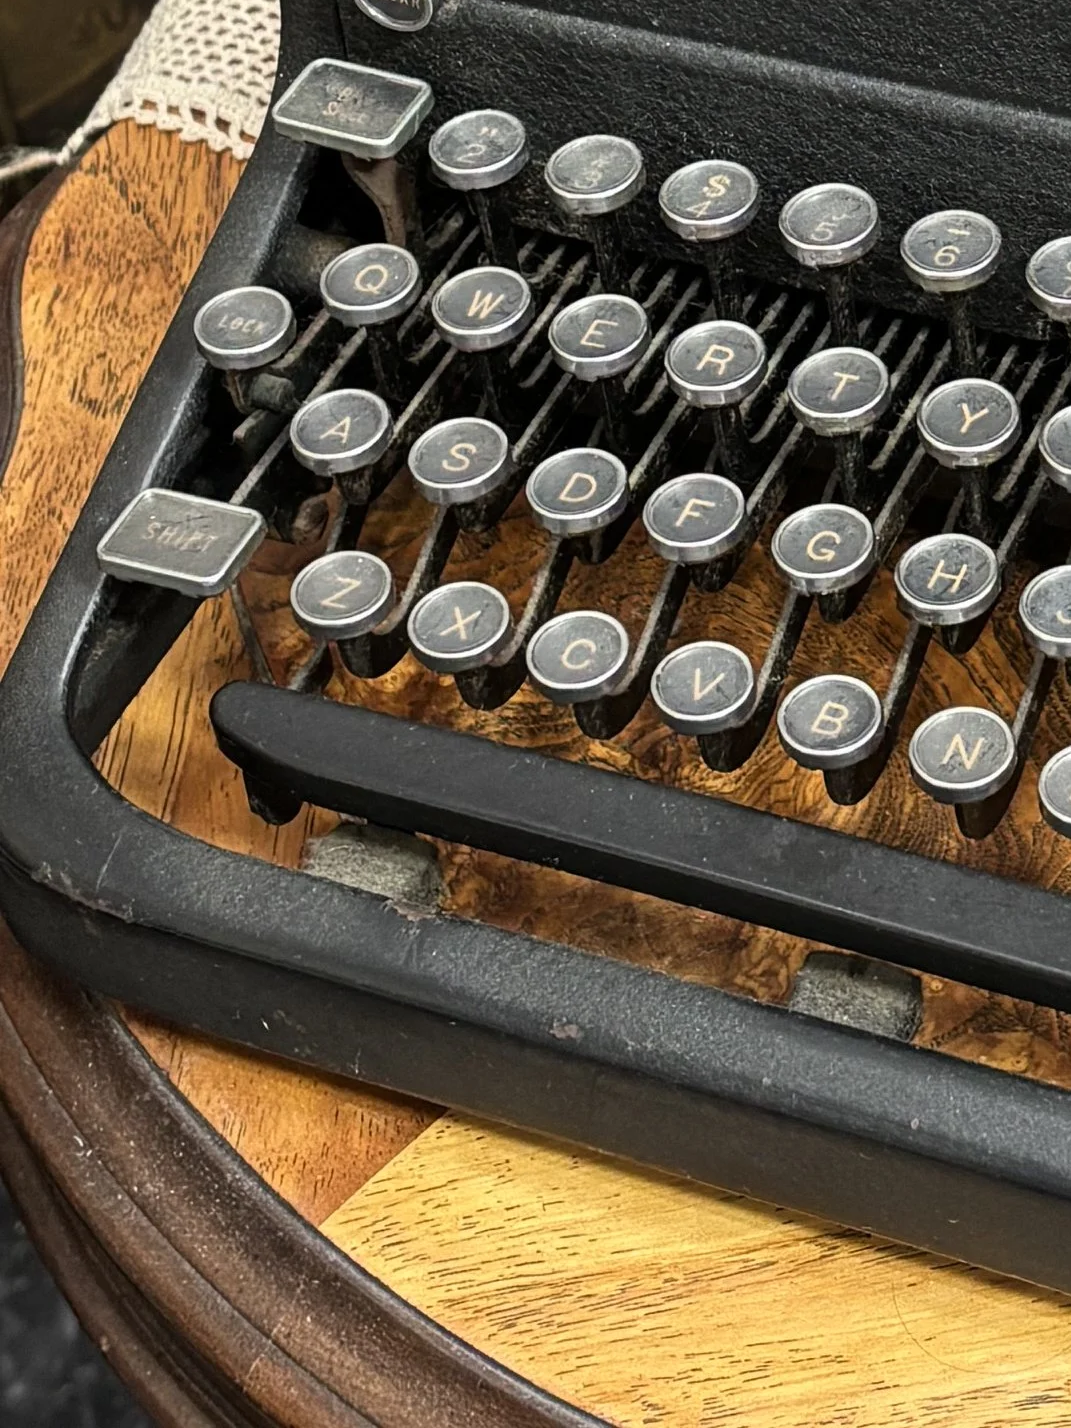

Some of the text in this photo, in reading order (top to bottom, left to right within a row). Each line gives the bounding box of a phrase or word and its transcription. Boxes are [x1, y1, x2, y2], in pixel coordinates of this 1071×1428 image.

[702, 174, 731, 199] $
[683, 200, 713, 219] 4
[811, 221, 839, 242] 5
[934, 244, 961, 266] 6
[354, 264, 388, 295] Q
[466, 289, 505, 319] W
[580, 318, 618, 349] E
[696, 343, 735, 376] R
[831, 371, 860, 401] T
[319, 415, 351, 444] A
[958, 402, 990, 434] Y
[442, 442, 477, 471] S
[558, 472, 597, 503] D
[675, 498, 716, 528] F
[806, 530, 842, 563] G
[320, 575, 362, 609] Z
[927, 559, 968, 594] H
[438, 606, 482, 640] X
[561, 638, 596, 670] C
[694, 667, 726, 702] V
[811, 699, 849, 738] B
[941, 732, 985, 771] N
